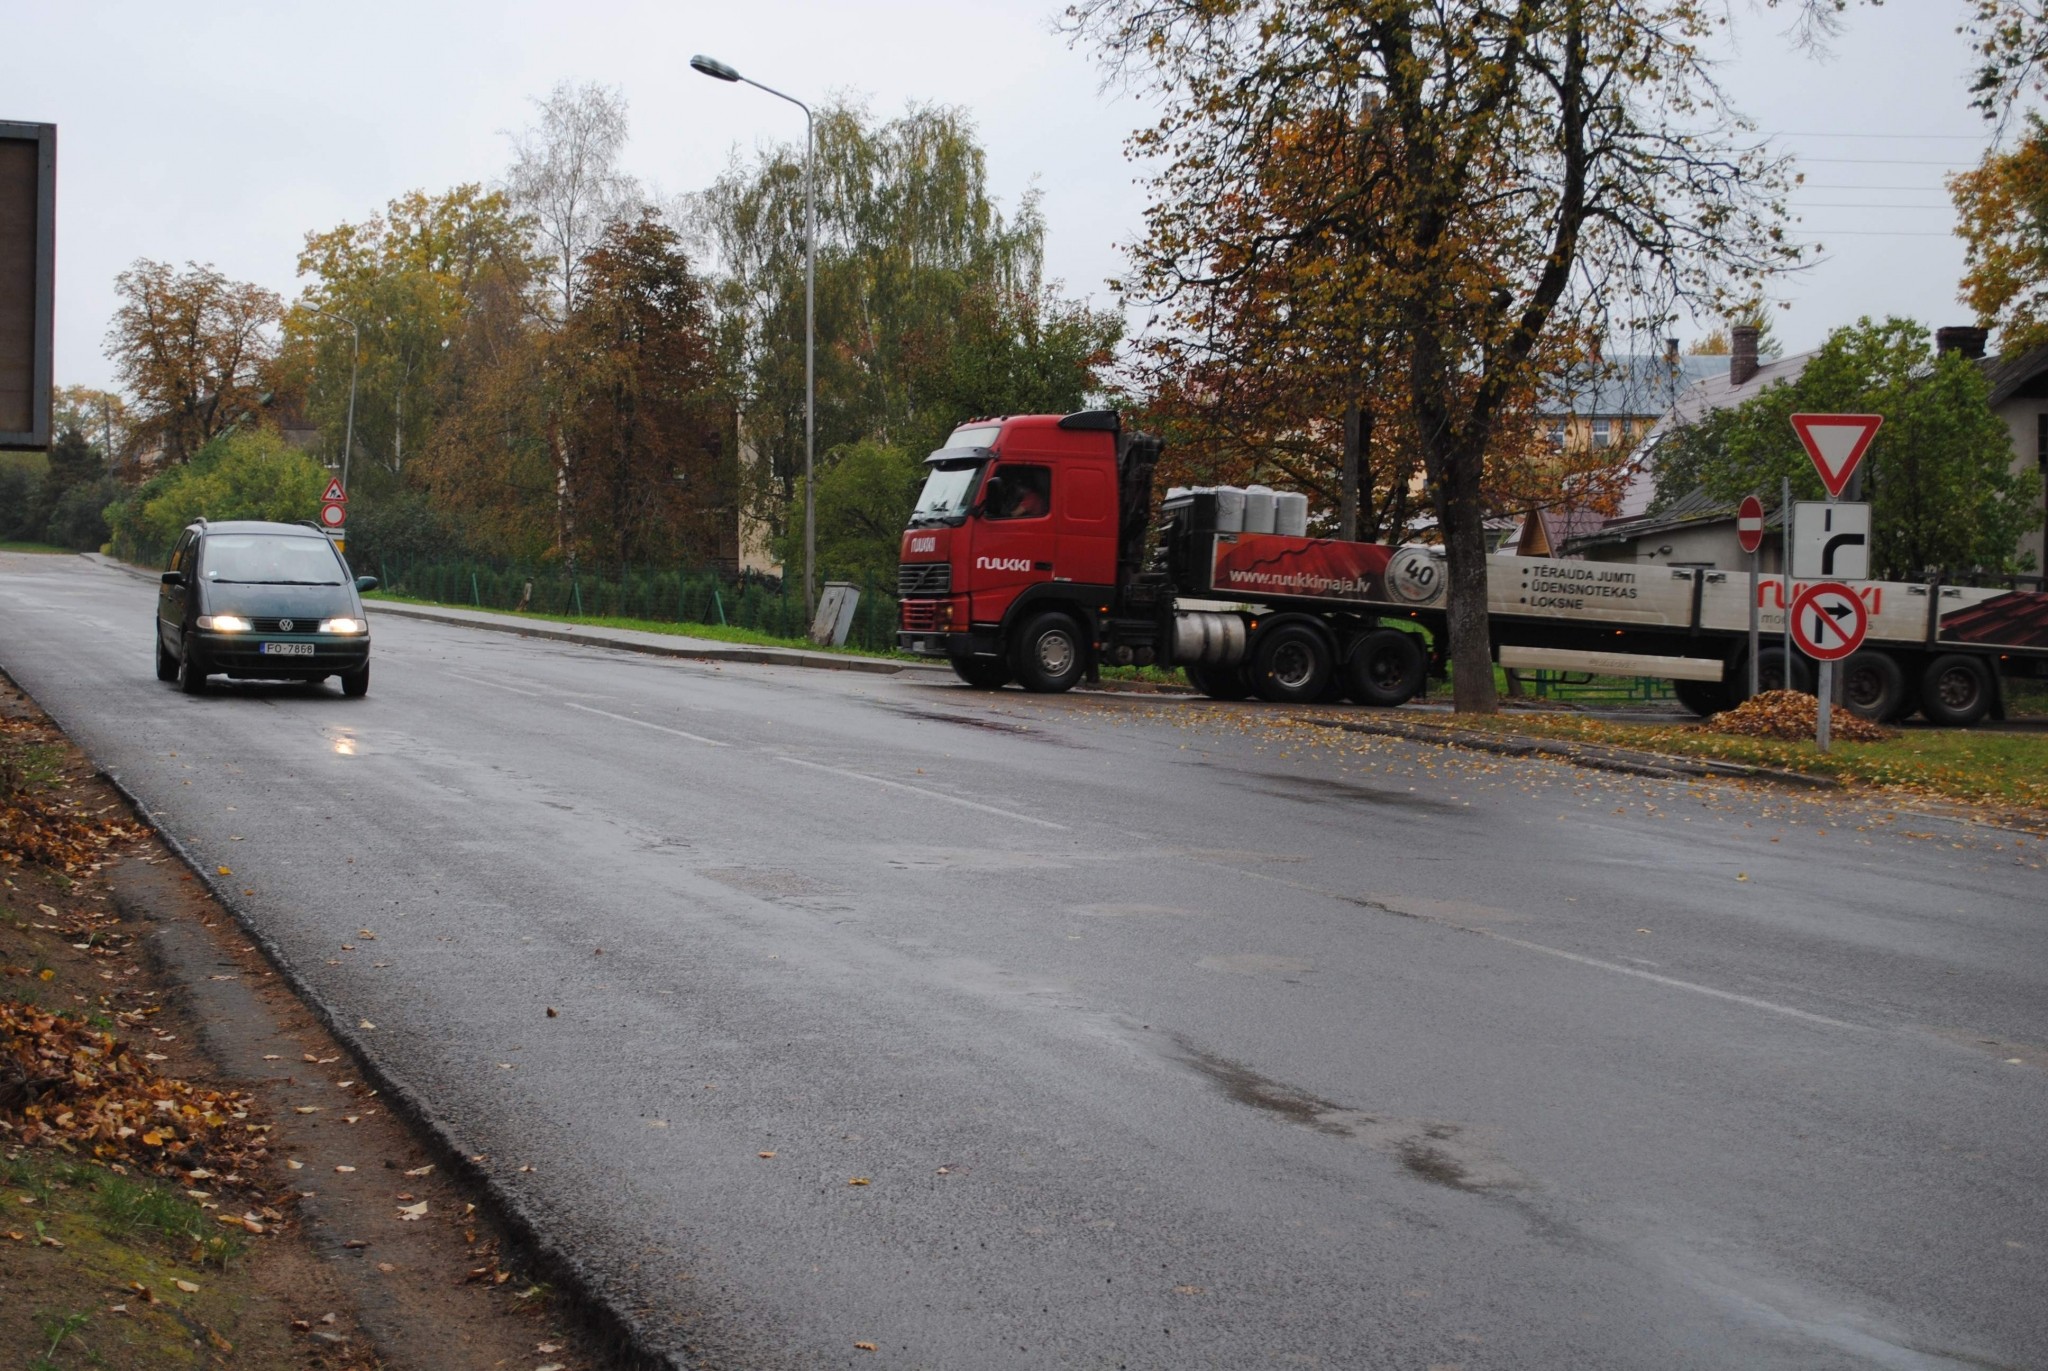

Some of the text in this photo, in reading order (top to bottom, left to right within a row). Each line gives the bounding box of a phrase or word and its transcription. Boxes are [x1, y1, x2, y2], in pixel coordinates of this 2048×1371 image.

[976, 556, 1031, 572] ruukki
[1404, 559, 1434, 585] 40
[1229, 569, 1371, 594] www.ruukkimaja.lv
[1533, 565, 1636, 584] TĒRAUDA JUMTI
[1532, 579, 1638, 599] ŪDENSNOTEKAS
[1530, 596, 1584, 610] LOKSNE
[267, 643, 313, 654] FO-7868
